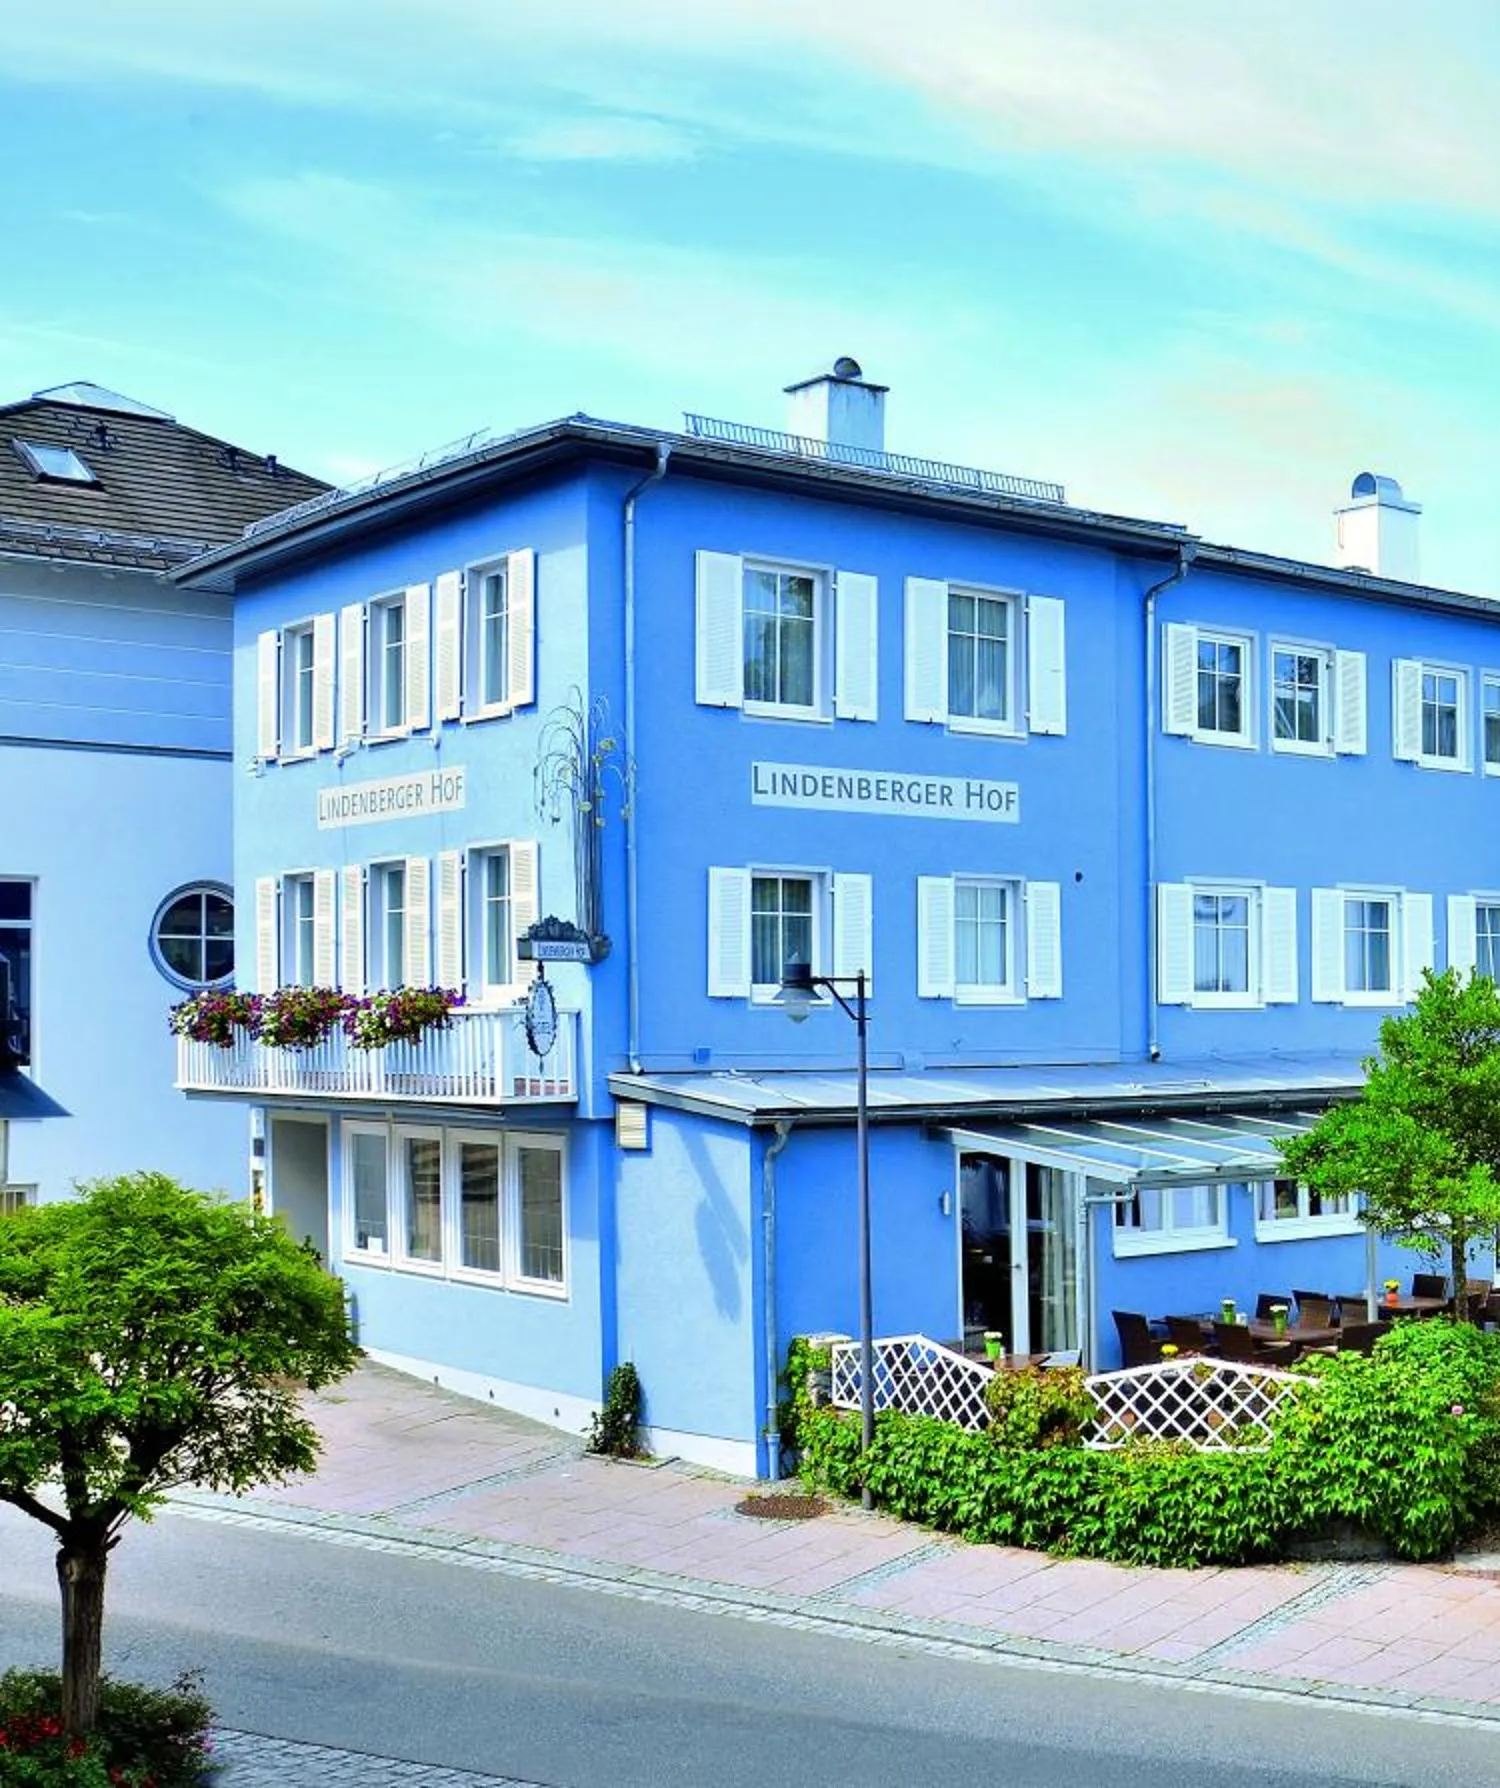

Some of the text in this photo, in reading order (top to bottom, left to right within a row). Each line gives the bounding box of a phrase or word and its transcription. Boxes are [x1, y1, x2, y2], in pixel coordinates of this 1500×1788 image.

[319, 774, 463, 821] LINDENBERGER HOF
[753, 765, 1017, 812] LINDENBERGER HOF
